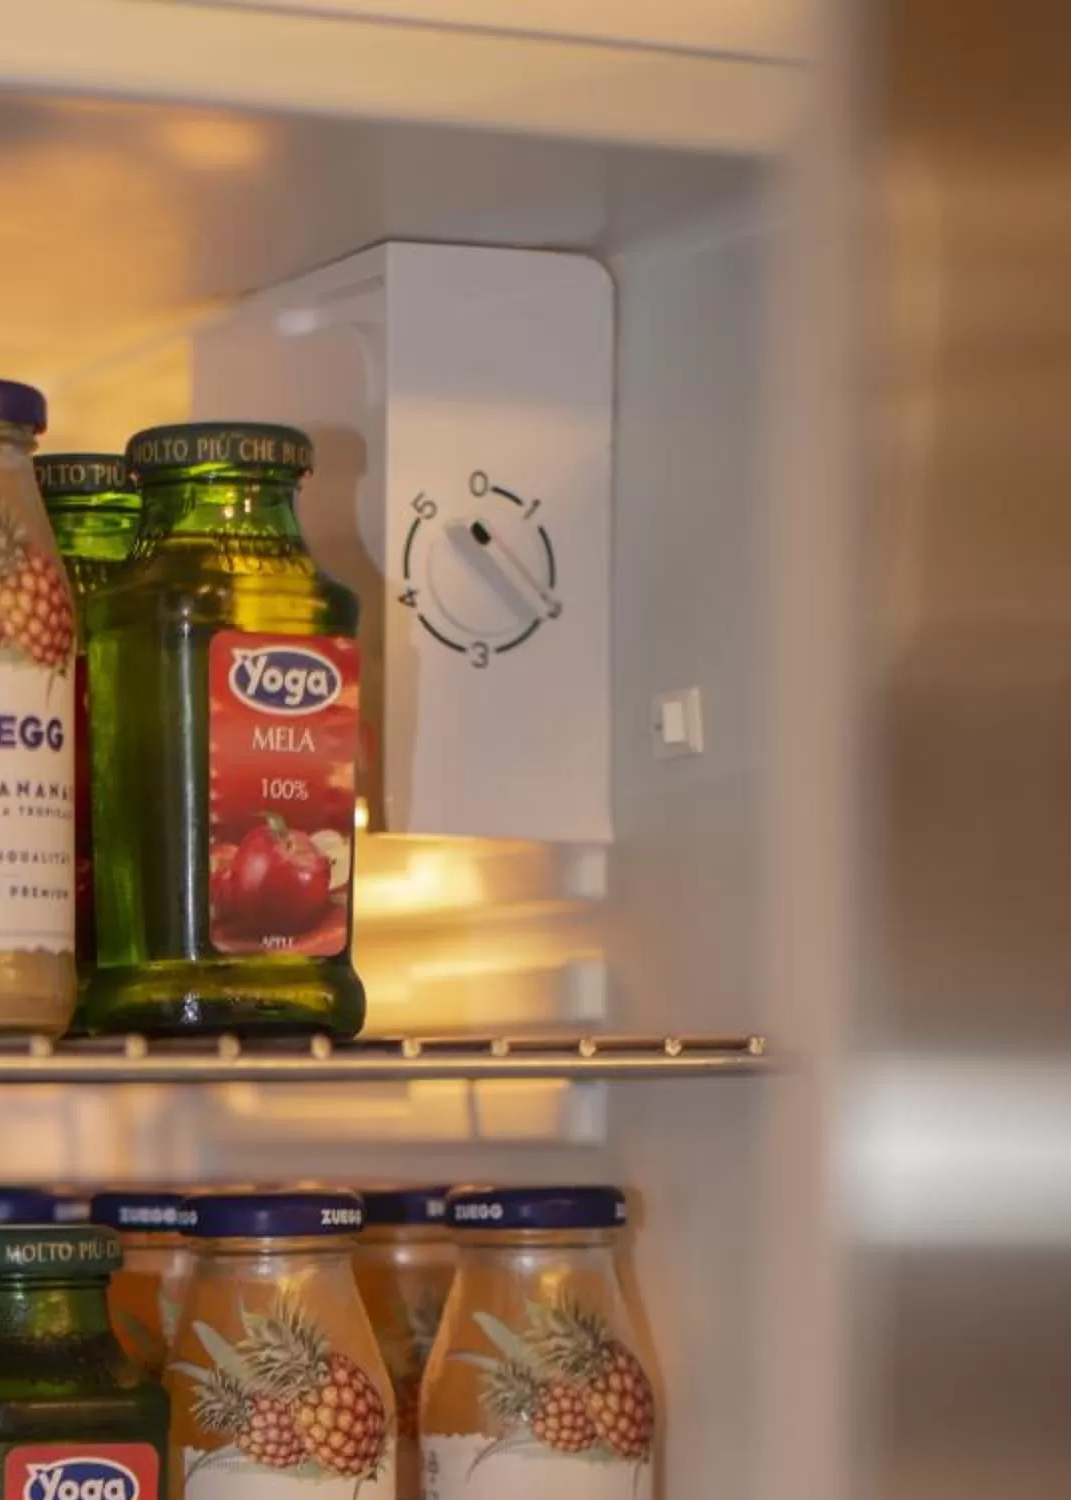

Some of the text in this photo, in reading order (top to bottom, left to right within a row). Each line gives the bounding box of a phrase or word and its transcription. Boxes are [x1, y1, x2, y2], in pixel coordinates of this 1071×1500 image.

[240, 439, 275, 462] CHE
[409, 492, 438, 520] 5
[397, 586, 419, 609] 4
[470, 640, 490, 669] 3
[237, 651, 331, 706] Yoga
[251, 726, 315, 753] MELA
[261, 778, 309, 801] 100%
[5, 1242, 73, 1264] MOLTO
